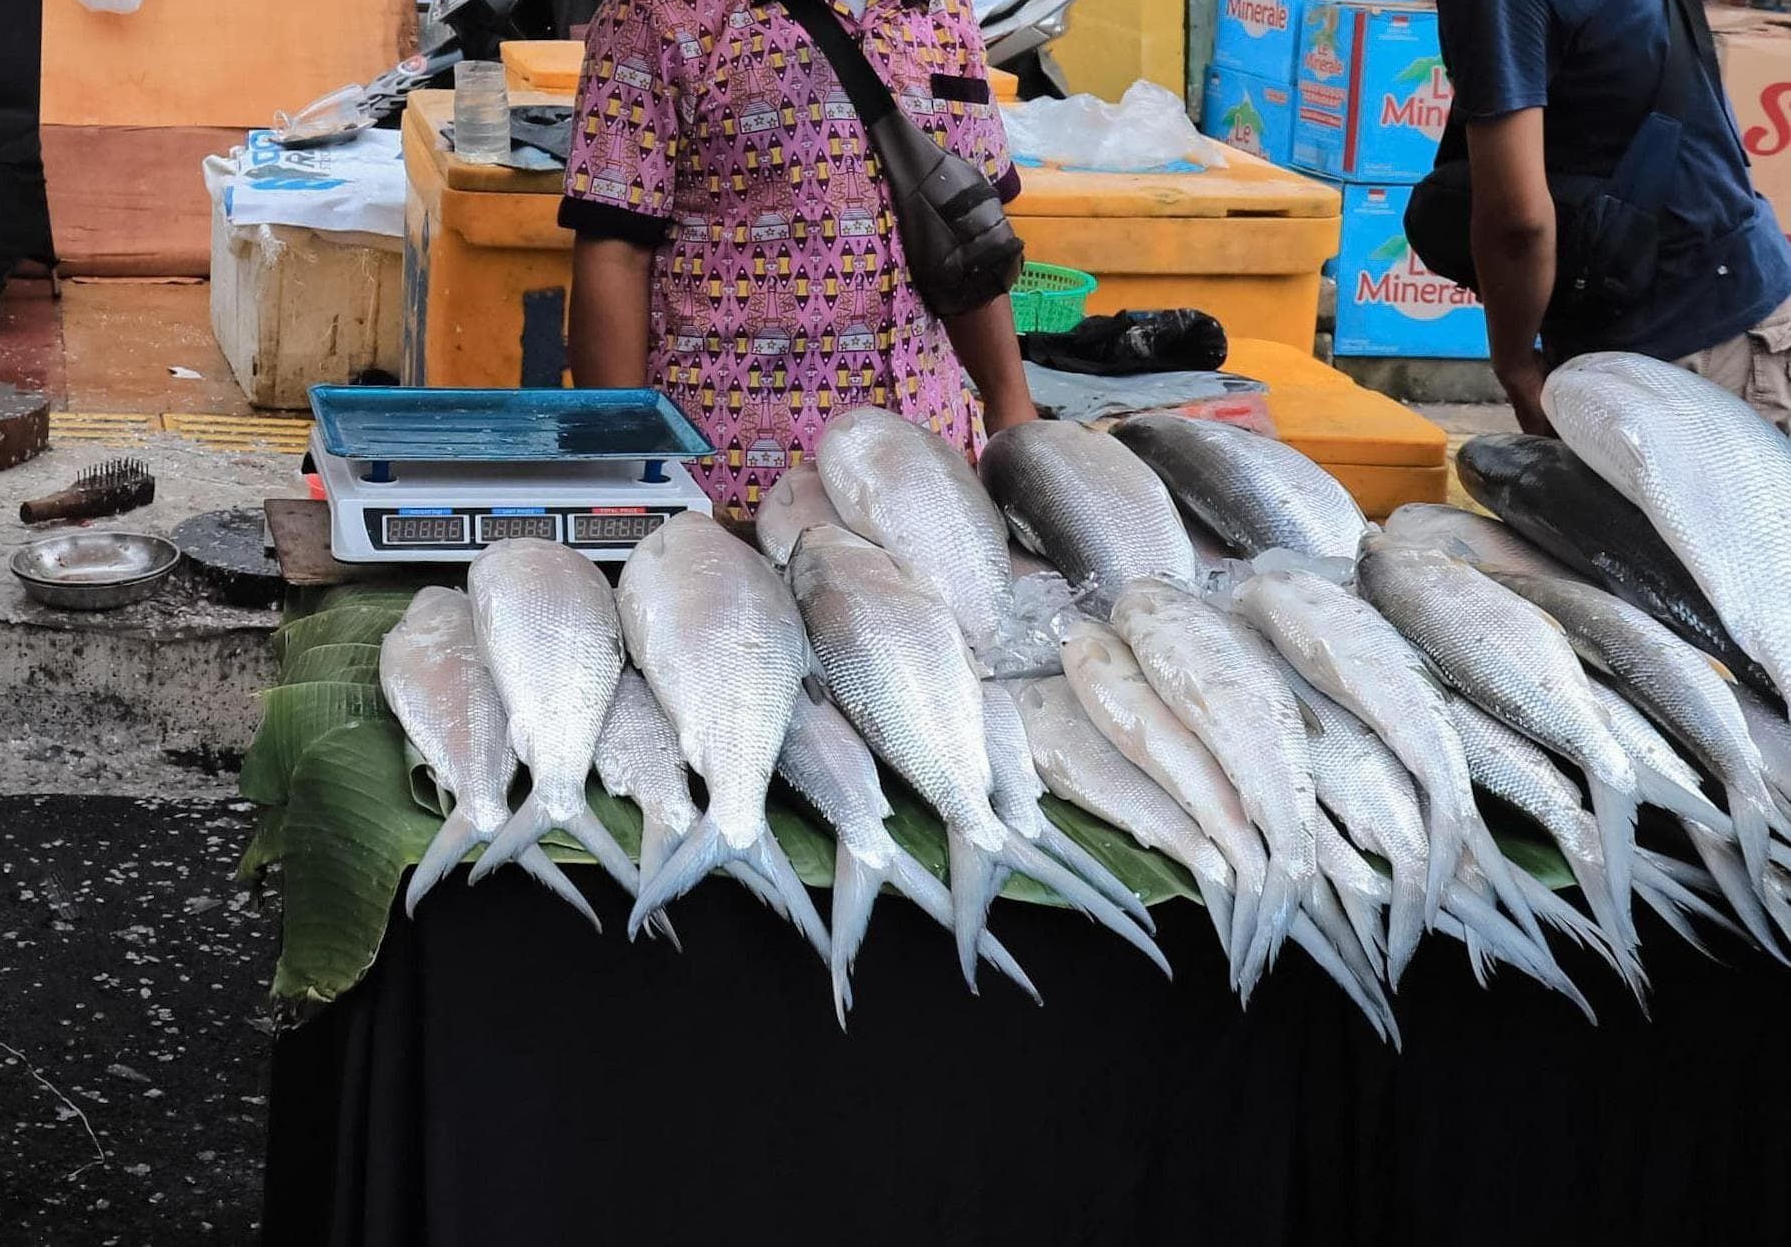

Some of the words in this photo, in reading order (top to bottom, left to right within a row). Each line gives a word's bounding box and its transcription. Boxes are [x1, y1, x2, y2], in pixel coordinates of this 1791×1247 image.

[1432, 67, 1454, 100] L
[1235, 114, 1251, 143] Le
[1409, 247, 1438, 277] L
